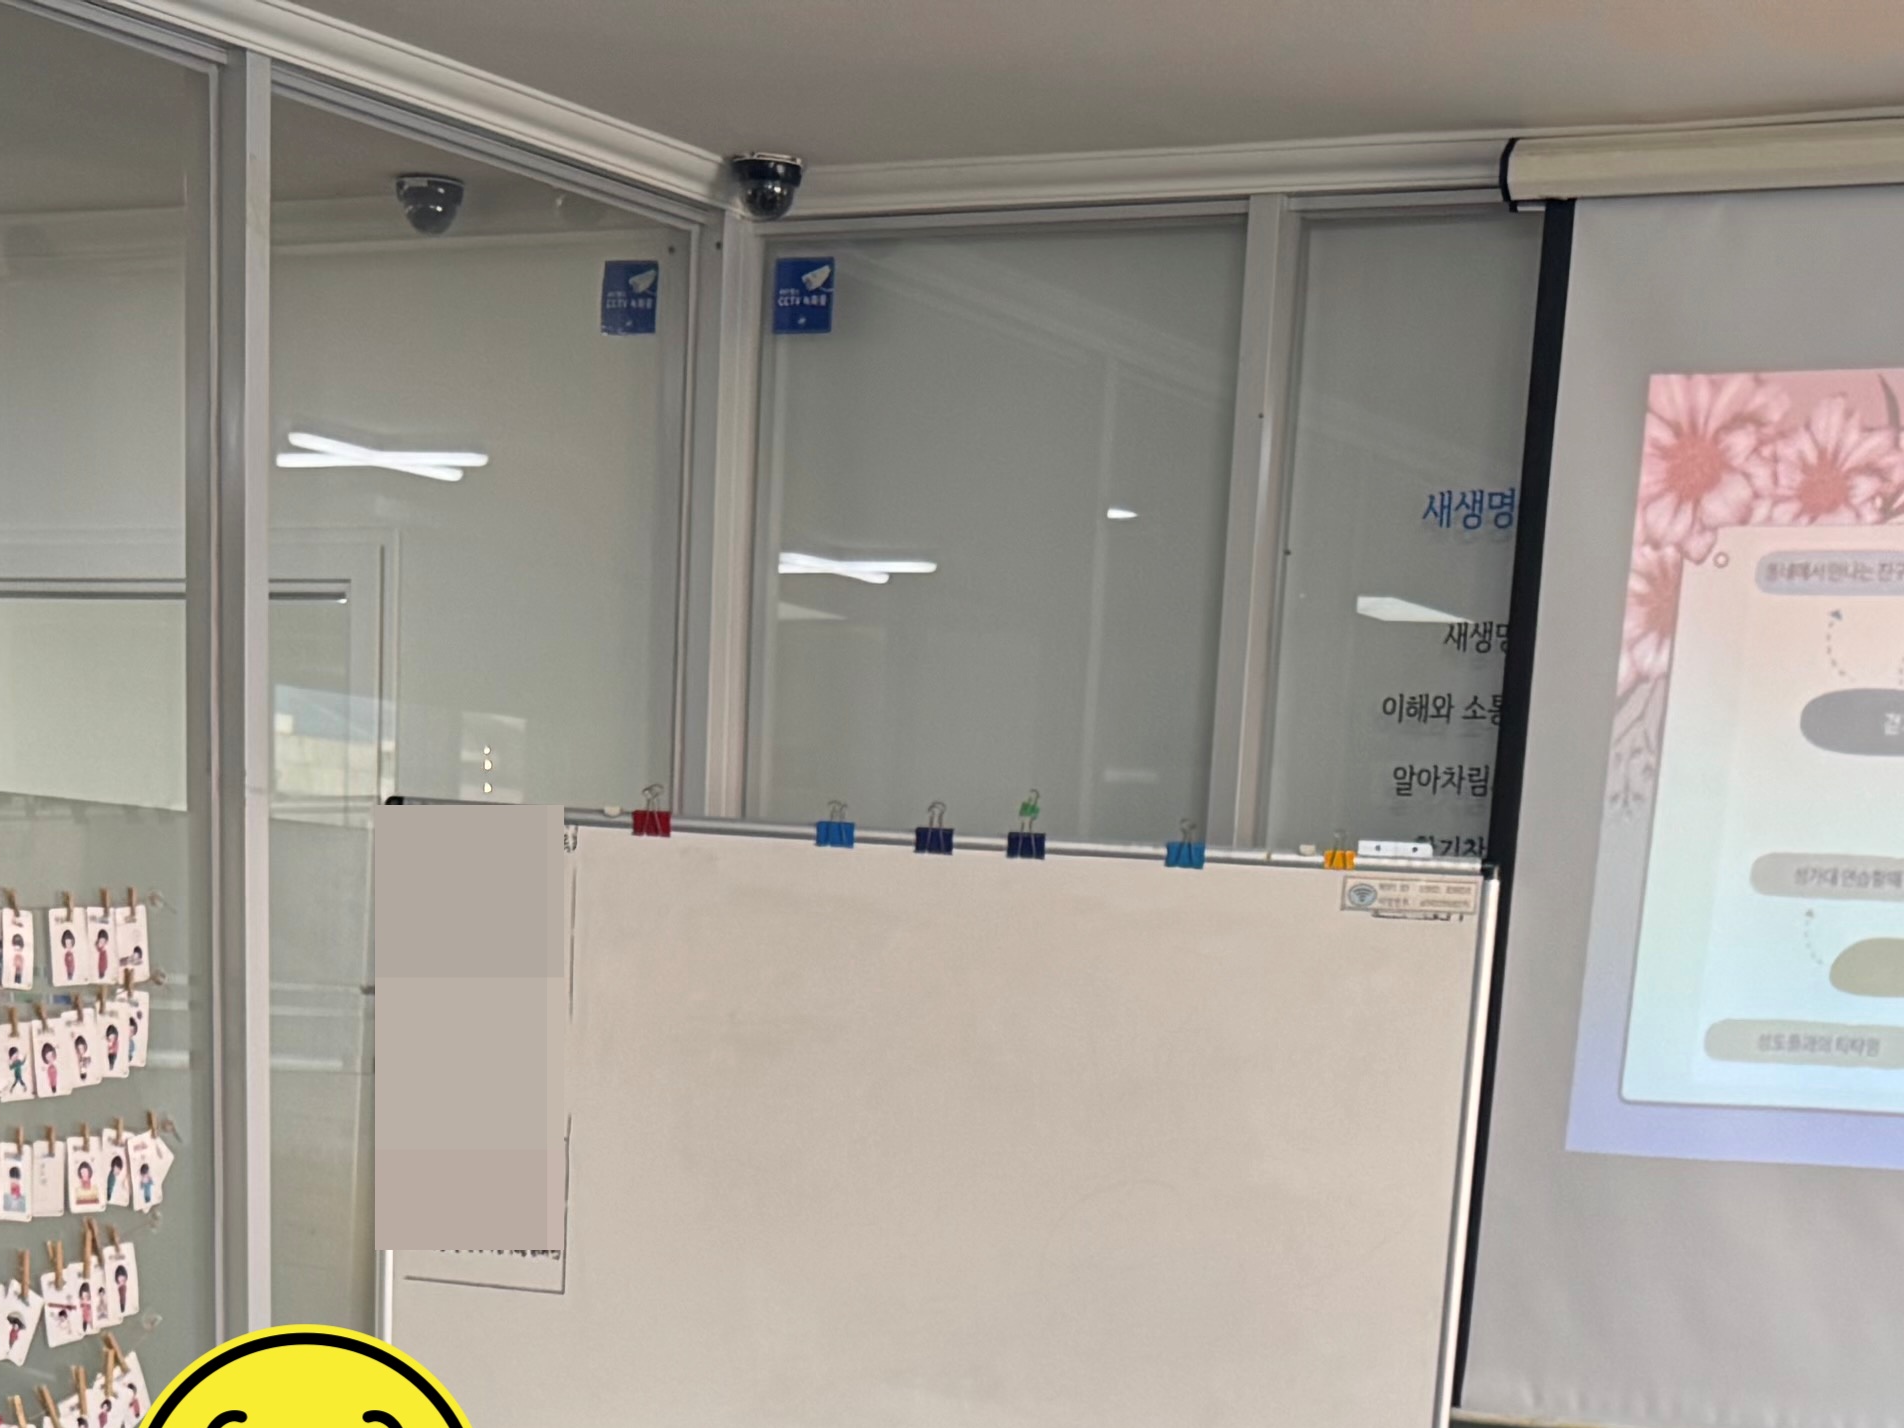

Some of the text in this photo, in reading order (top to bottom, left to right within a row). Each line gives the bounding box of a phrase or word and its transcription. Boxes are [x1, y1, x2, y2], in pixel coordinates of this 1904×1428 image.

[1422, 488, 1516, 530] 새생명
[1382, 692, 1455, 725] 이해와
[1393, 764, 1489, 798] 알아차림
